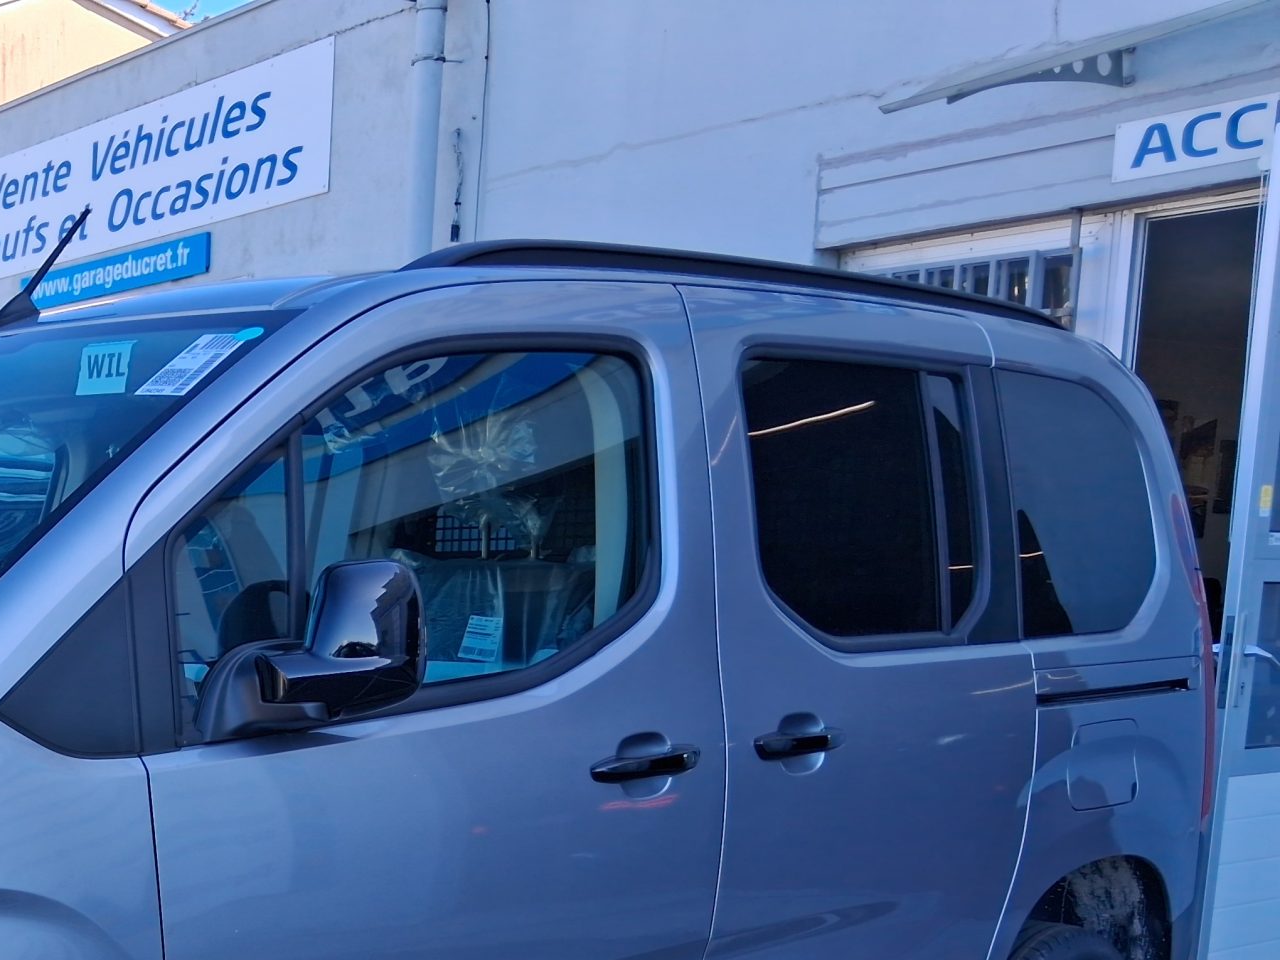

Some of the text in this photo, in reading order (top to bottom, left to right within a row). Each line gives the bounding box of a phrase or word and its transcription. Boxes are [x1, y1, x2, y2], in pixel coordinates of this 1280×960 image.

[90, 90, 272, 182] Véhicules
[1130, 99, 1280, 169] ACC
[107, 144, 304, 233] Occasions
[87, 352, 126, 380] WIL
